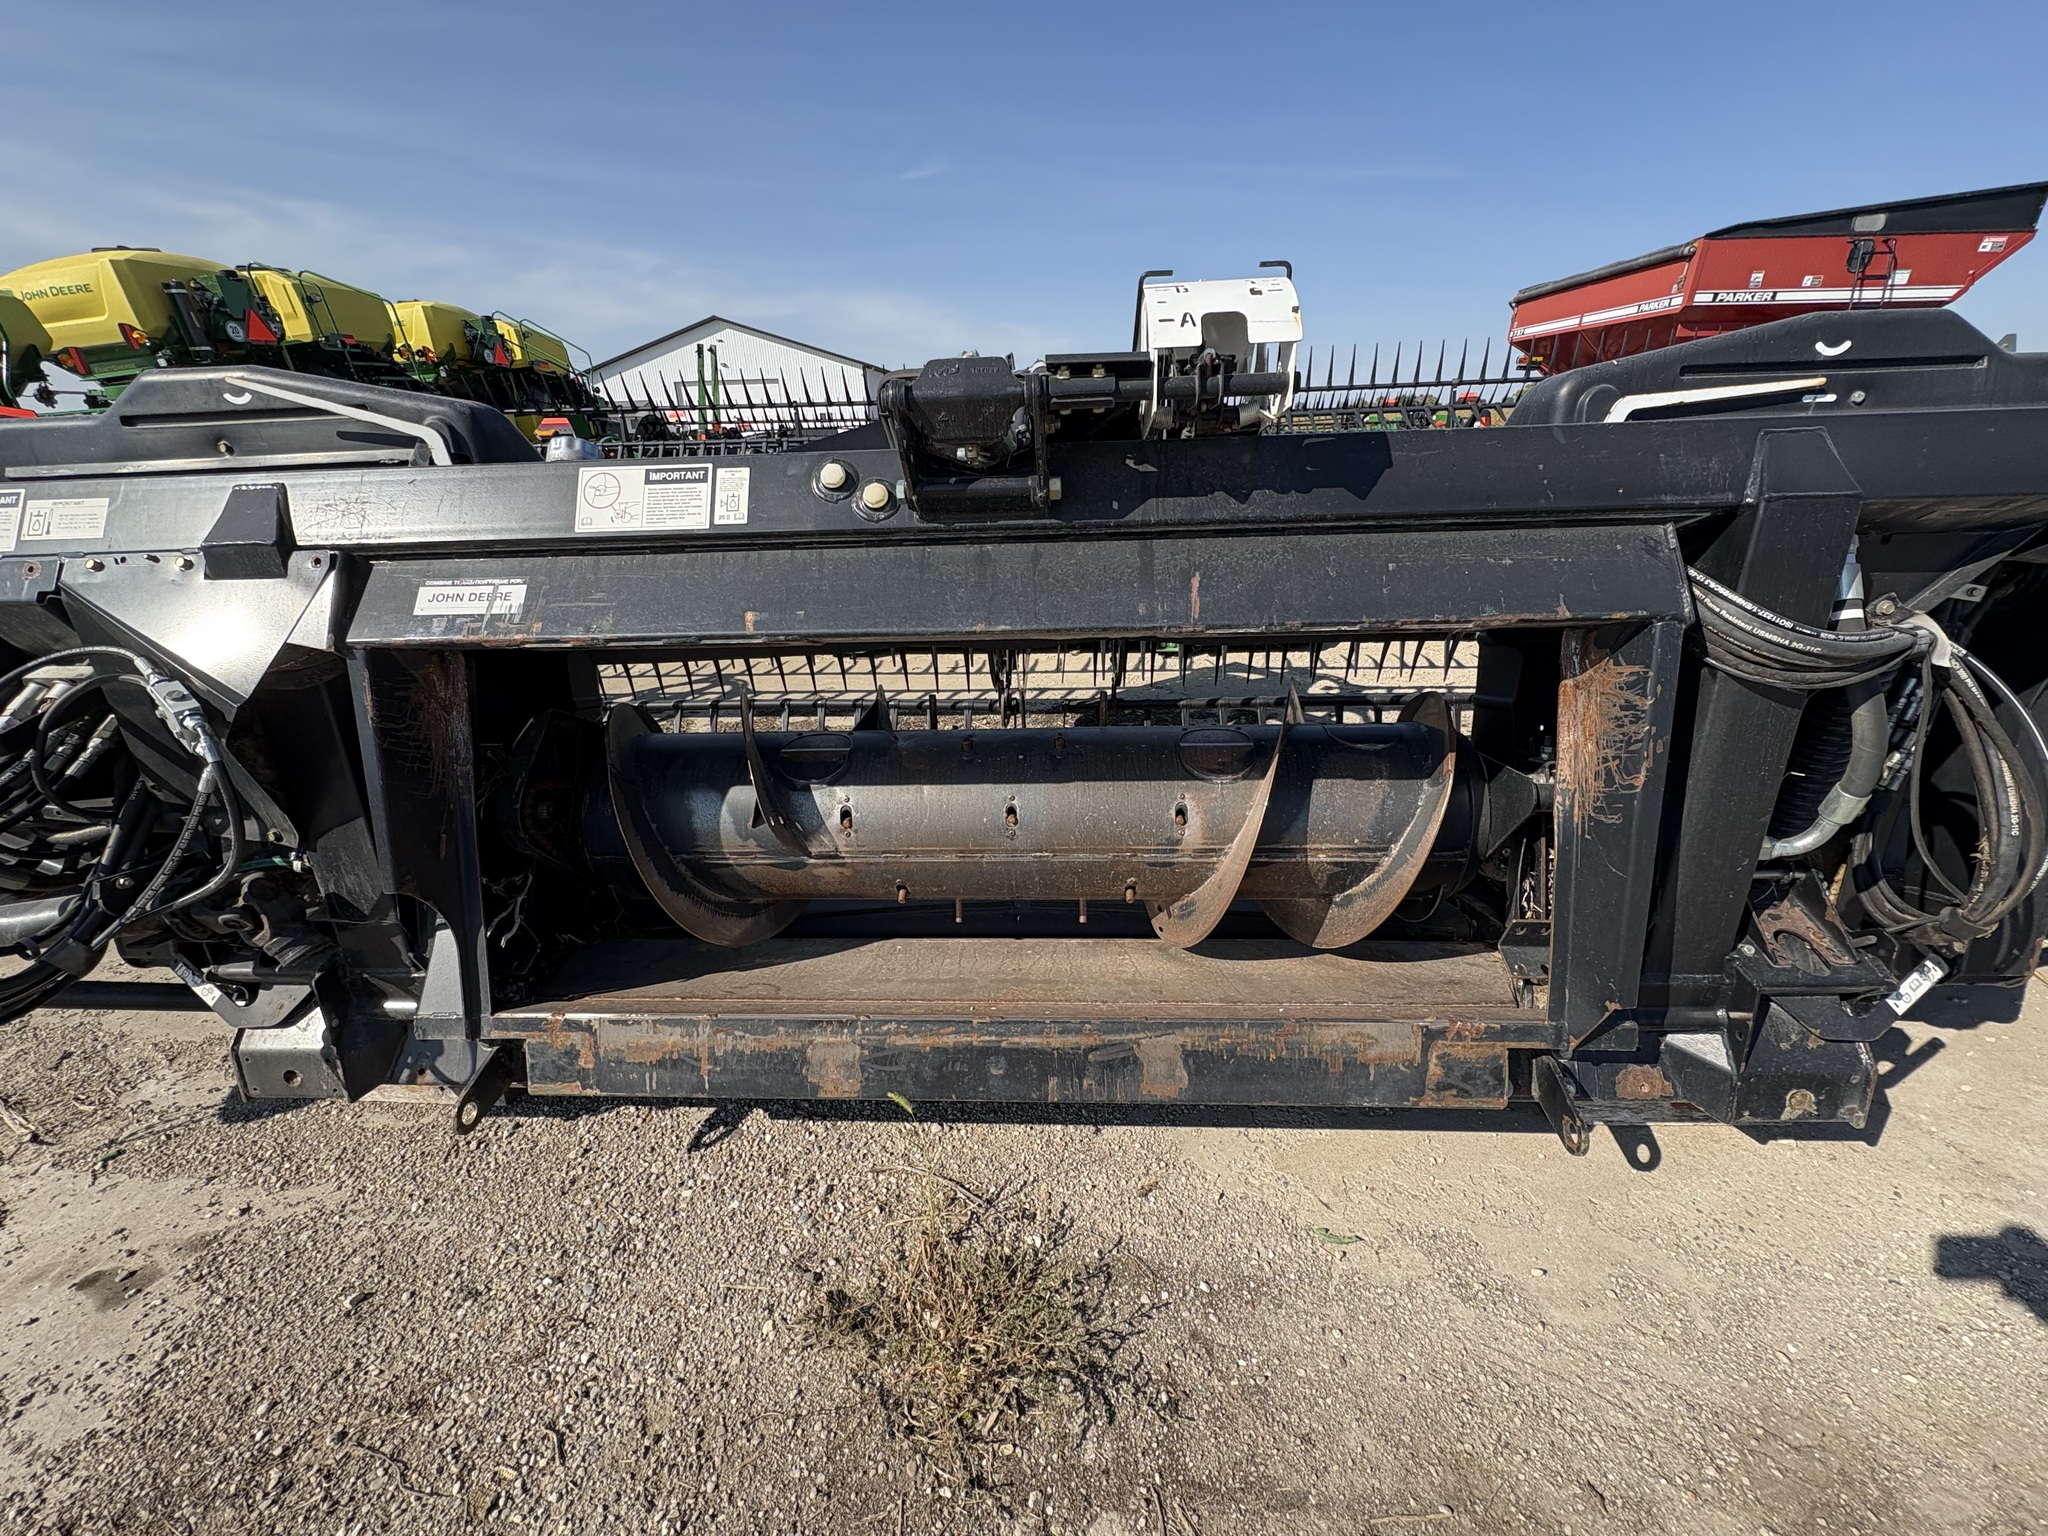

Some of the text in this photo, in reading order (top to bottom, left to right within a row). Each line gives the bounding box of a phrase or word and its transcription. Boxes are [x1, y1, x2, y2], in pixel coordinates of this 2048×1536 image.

[20, 283, 94, 301] JOHN DEERE
[1715, 292, 1774, 302] PARKER
[1639, 299, 1671, 313] PARKER
[1180, 311, 1197, 328] A
[649, 470, 705, 481] IMPORTANT
[427, 591, 513, 603] JOHN DEERE
[1719, 609, 1753, 632] Resistant
[1752, 626, 1791, 648] USMSHA
